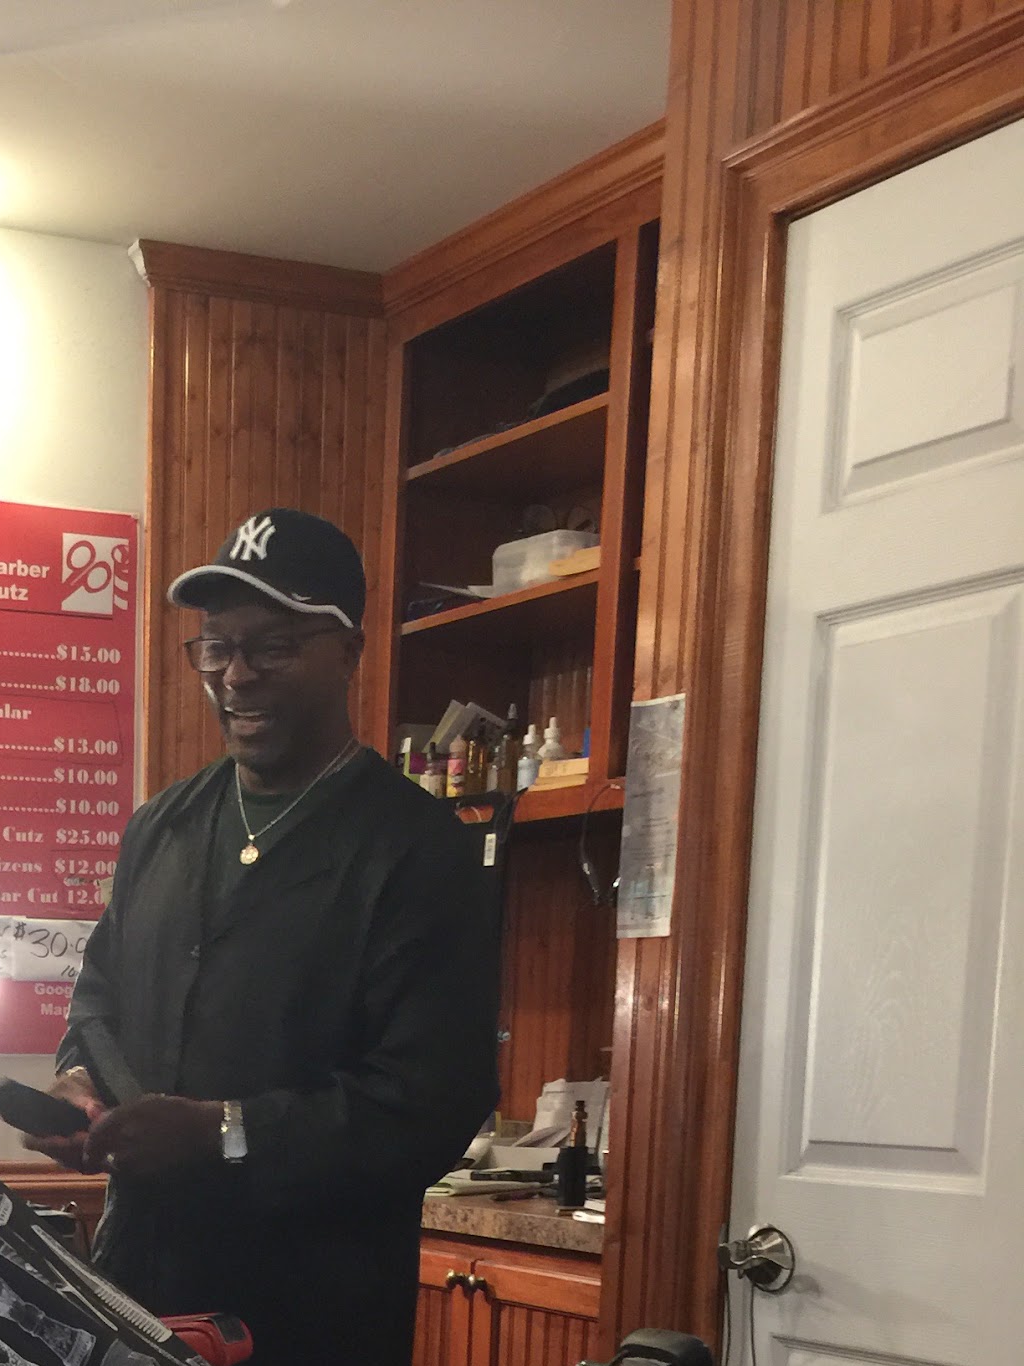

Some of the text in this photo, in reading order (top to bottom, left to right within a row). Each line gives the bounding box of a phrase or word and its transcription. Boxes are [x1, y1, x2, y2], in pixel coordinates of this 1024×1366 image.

[229, 516, 276, 561] NY
[56, 644, 121, 664] $15.00
[55, 675, 120, 695] $18.00
[54, 736, 118, 755] $13.00
[54, 767, 118, 786] $10.00
[56, 798, 119, 816] $10.00
[3, 826, 44, 842] Cutz
[56, 828, 119, 846] $25.00
[55, 858, 117, 875] $12.00
[27, 888, 58, 904] Cut
[68, 889, 104, 905] 12.0
[34, 983, 73, 998] Goog
